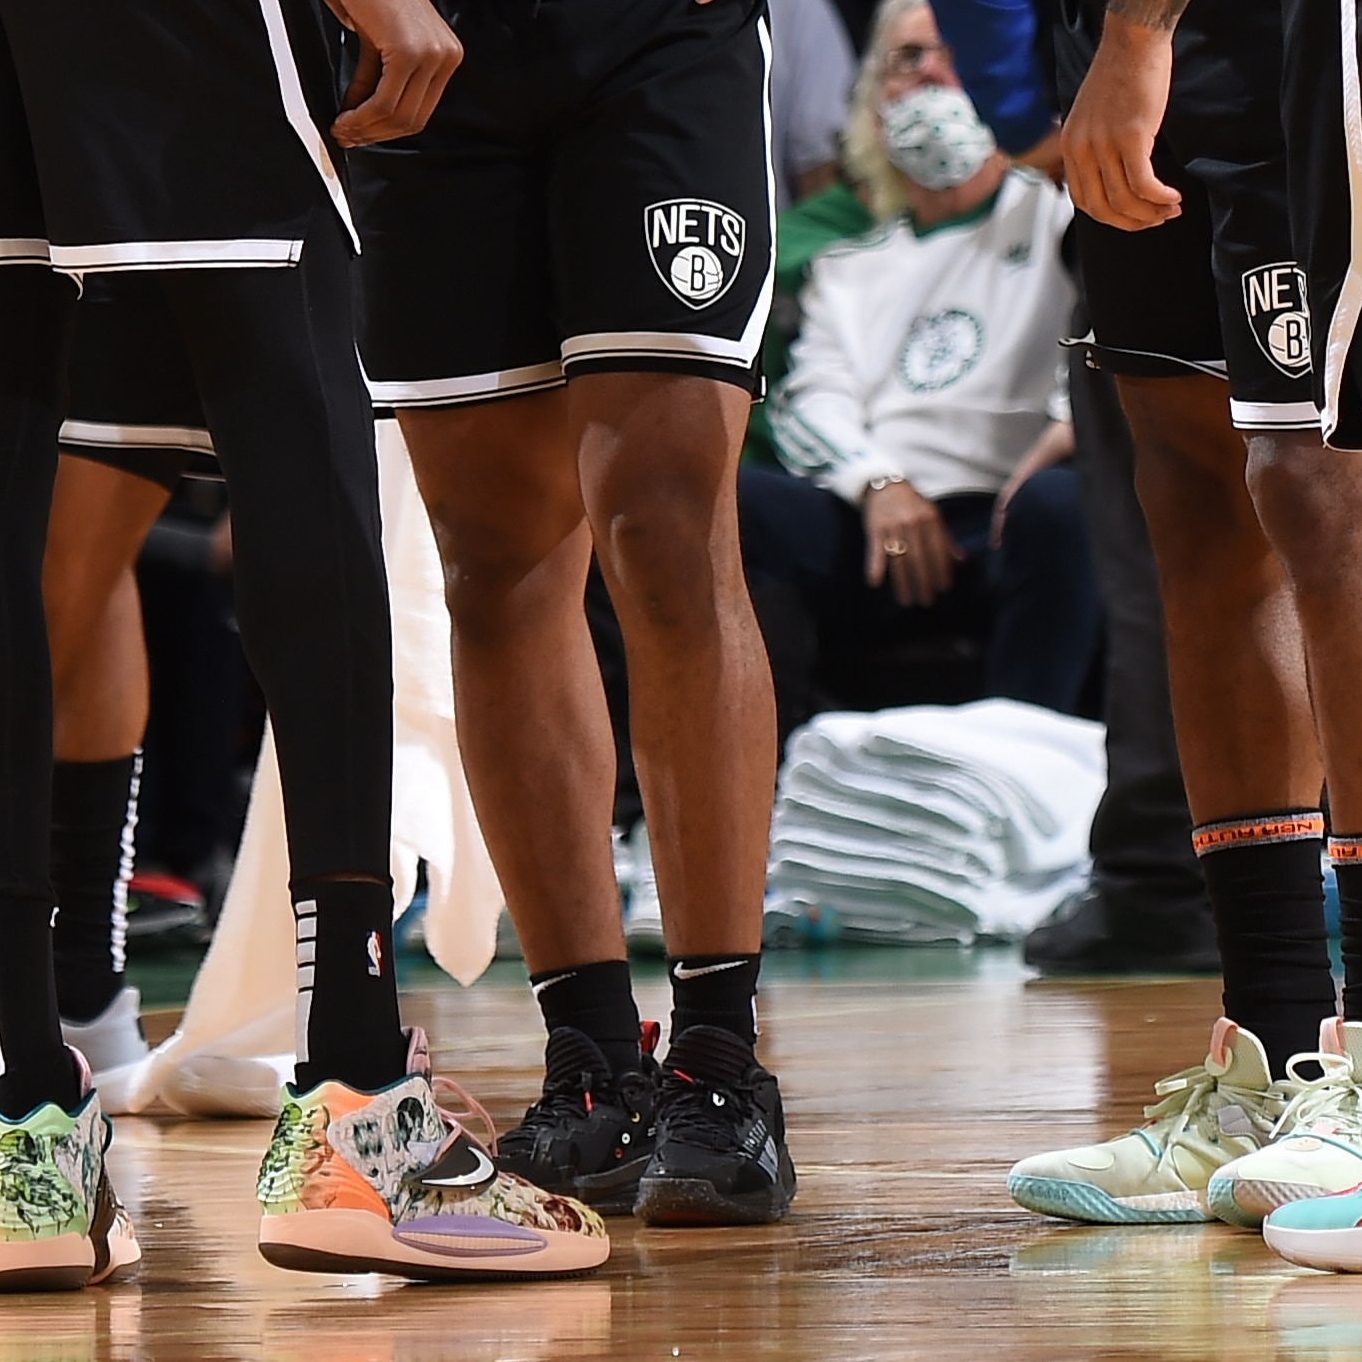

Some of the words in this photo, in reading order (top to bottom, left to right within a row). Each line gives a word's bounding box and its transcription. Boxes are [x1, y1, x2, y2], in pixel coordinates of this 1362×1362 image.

[652, 204, 740, 257] NETS
[691, 255, 705, 291] B
[1286, 320, 1303, 359] B
